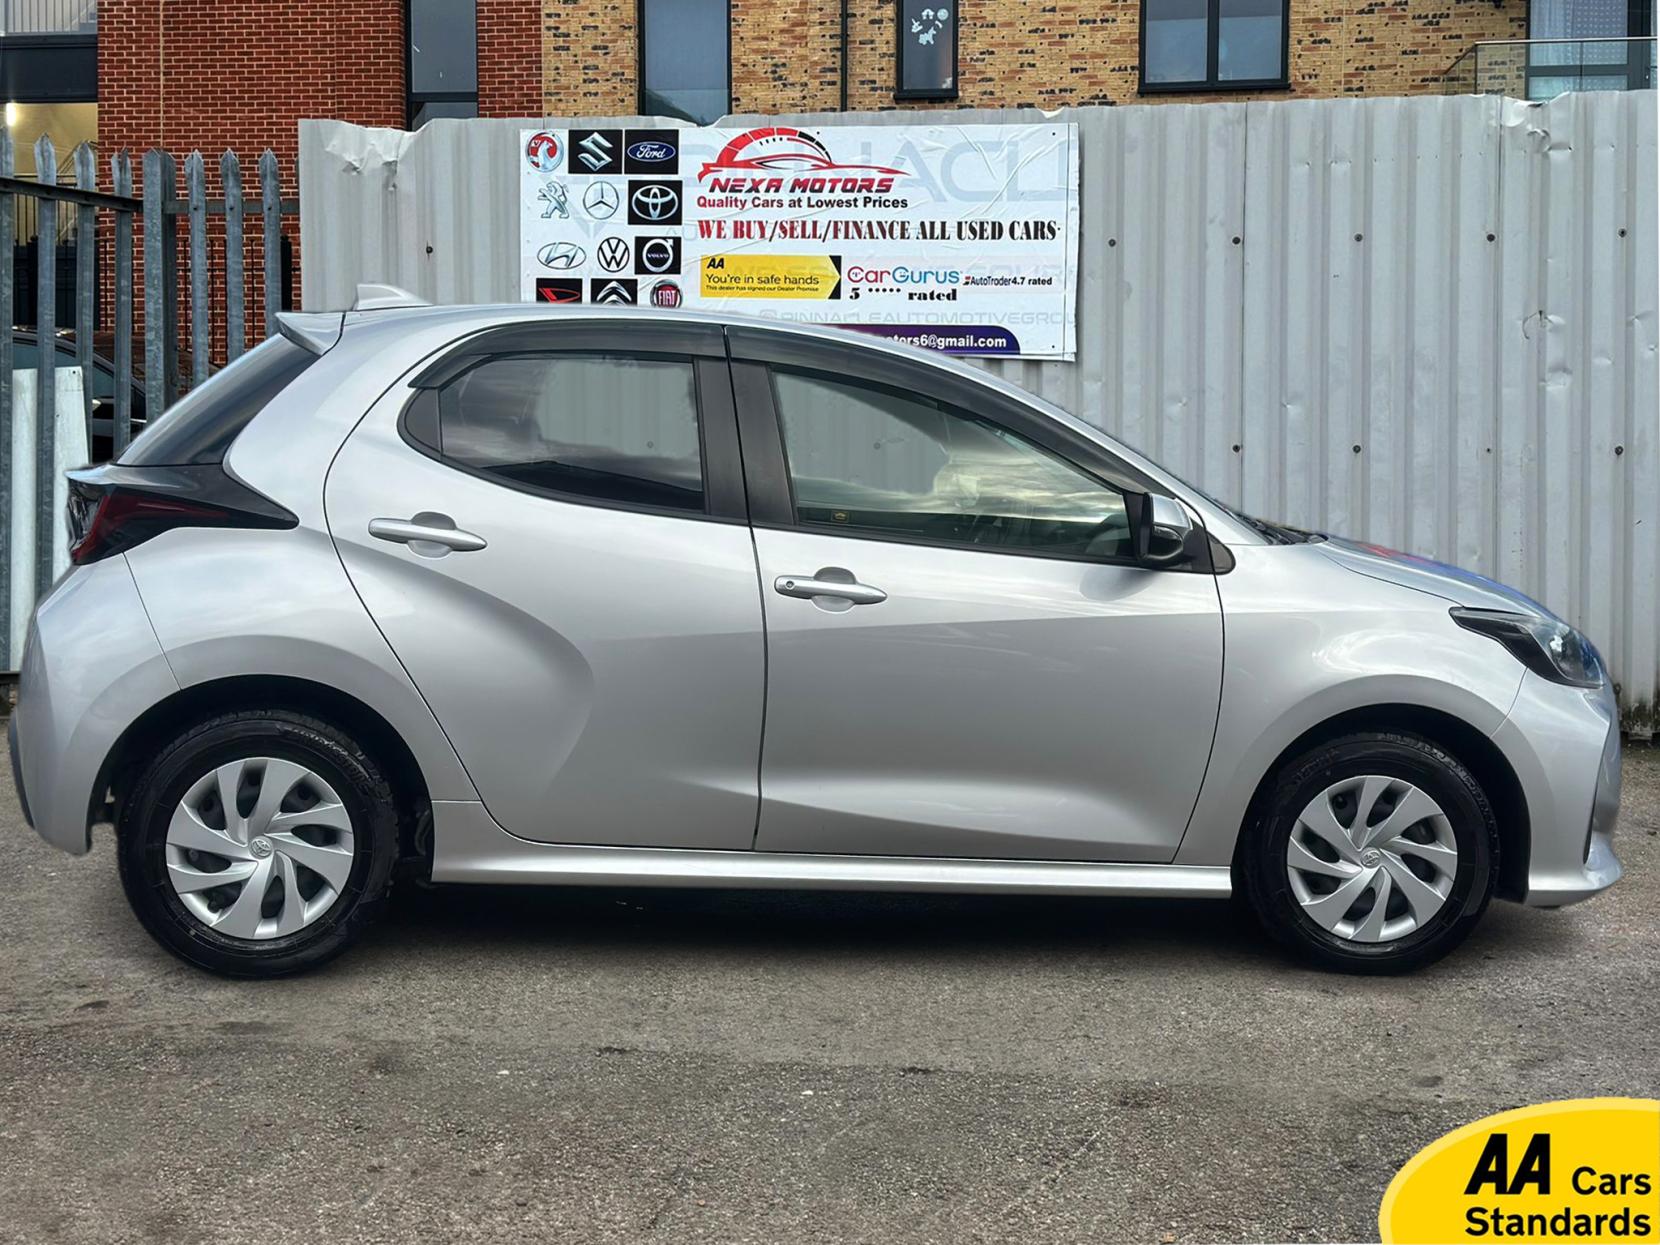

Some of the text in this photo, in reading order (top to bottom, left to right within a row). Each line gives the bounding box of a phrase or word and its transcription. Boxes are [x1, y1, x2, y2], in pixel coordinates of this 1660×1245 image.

[636, 144, 666, 159] Ford
[708, 177, 895, 194] NEXA MOTORS
[697, 196, 908, 210] Quality Cars at Lowest Prices
[698, 220, 727, 239] WE
[915, 220, 951, 240] ALL
[956, 220, 1004, 241] USED
[1009, 220, 1057, 241] CARS
[706, 257, 725, 269] AA
[705, 273, 819, 285] You're in safe hands
[847, 266, 960, 284] CarGurus
[1028, 276, 1053, 286] rated
[658, 290, 676, 305] FIAT
[849, 287, 957, 301] 5 rated
